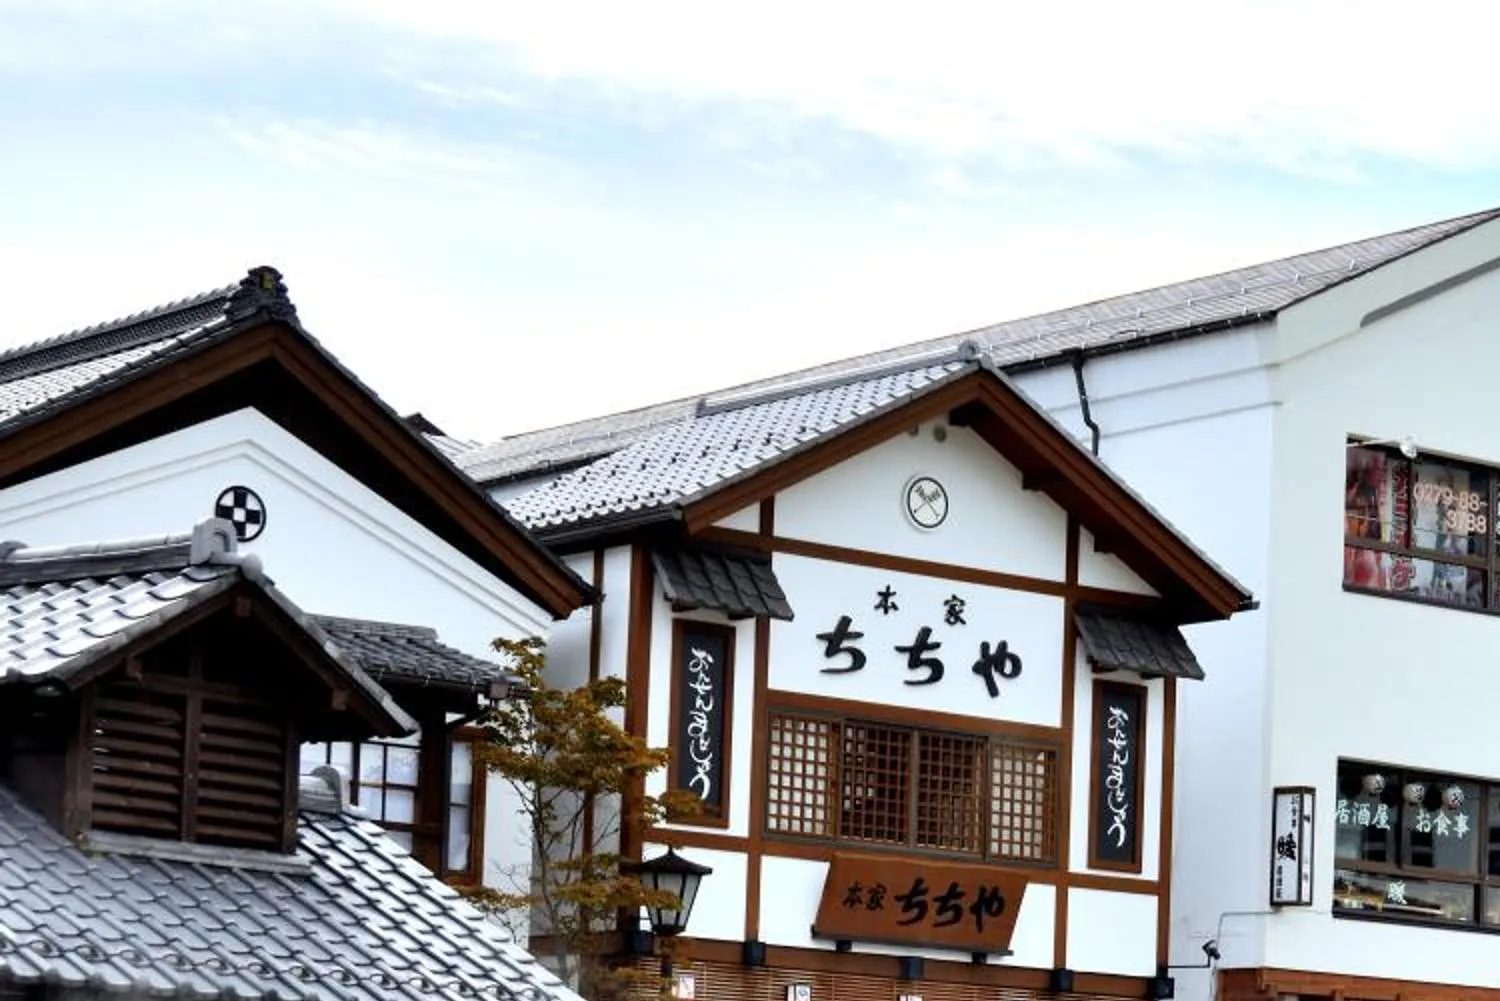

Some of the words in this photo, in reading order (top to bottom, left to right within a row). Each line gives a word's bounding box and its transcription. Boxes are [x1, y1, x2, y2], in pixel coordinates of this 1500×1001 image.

[874, 584, 967, 626] 本家
[815, 614, 1023, 699] ちちや
[1336, 799, 1390, 831] 居酒屋
[1415, 808, 1470, 839] お食事
[843, 881, 887, 911] 本家
[894, 878, 1005, 933] ちちや
